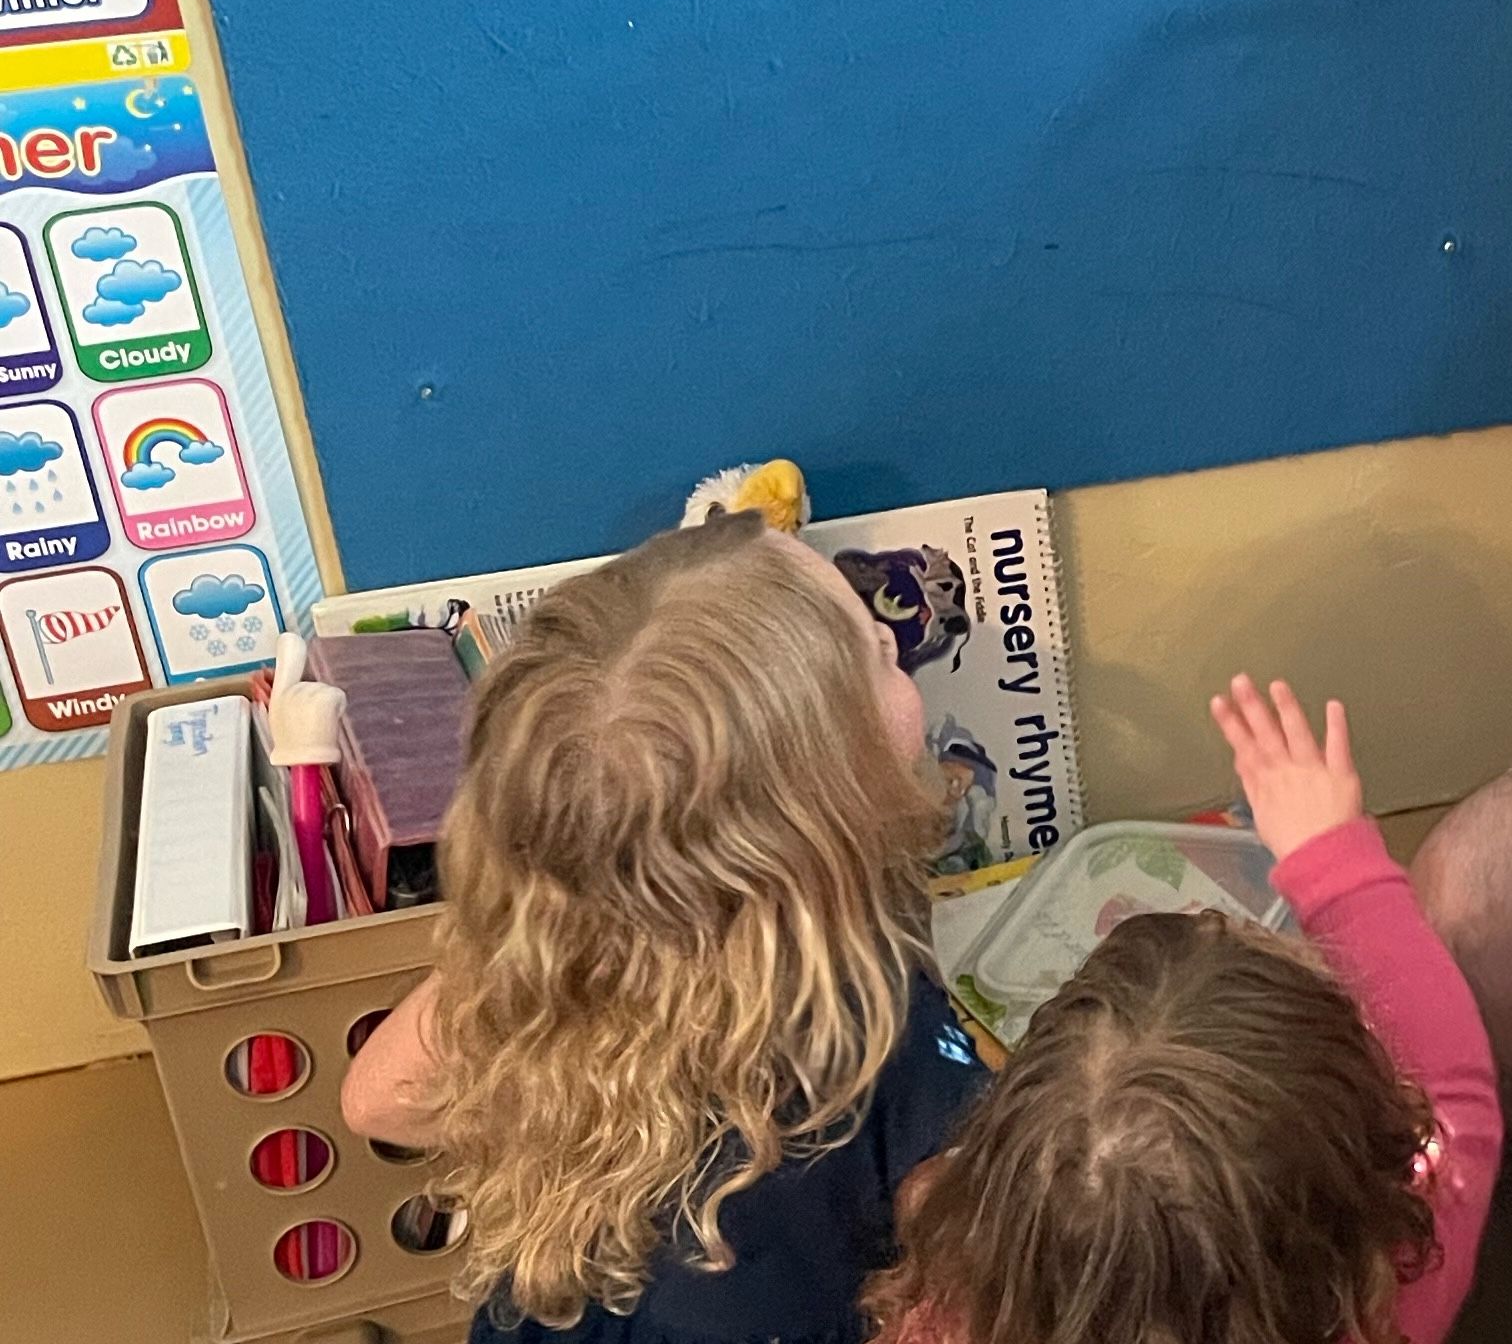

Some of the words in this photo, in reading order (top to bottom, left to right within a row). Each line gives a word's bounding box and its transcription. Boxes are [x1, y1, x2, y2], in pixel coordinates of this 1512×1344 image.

[98, 340, 193, 371] Cloudy
[135, 510, 246, 540] Rainbow
[962, 514, 975, 536] The
[5, 535, 78, 562] Rainy
[968, 554, 980, 574] and
[971, 574, 983, 595] the
[989, 527, 1043, 696] nursery
[1008, 713, 1061, 856] rhyme
